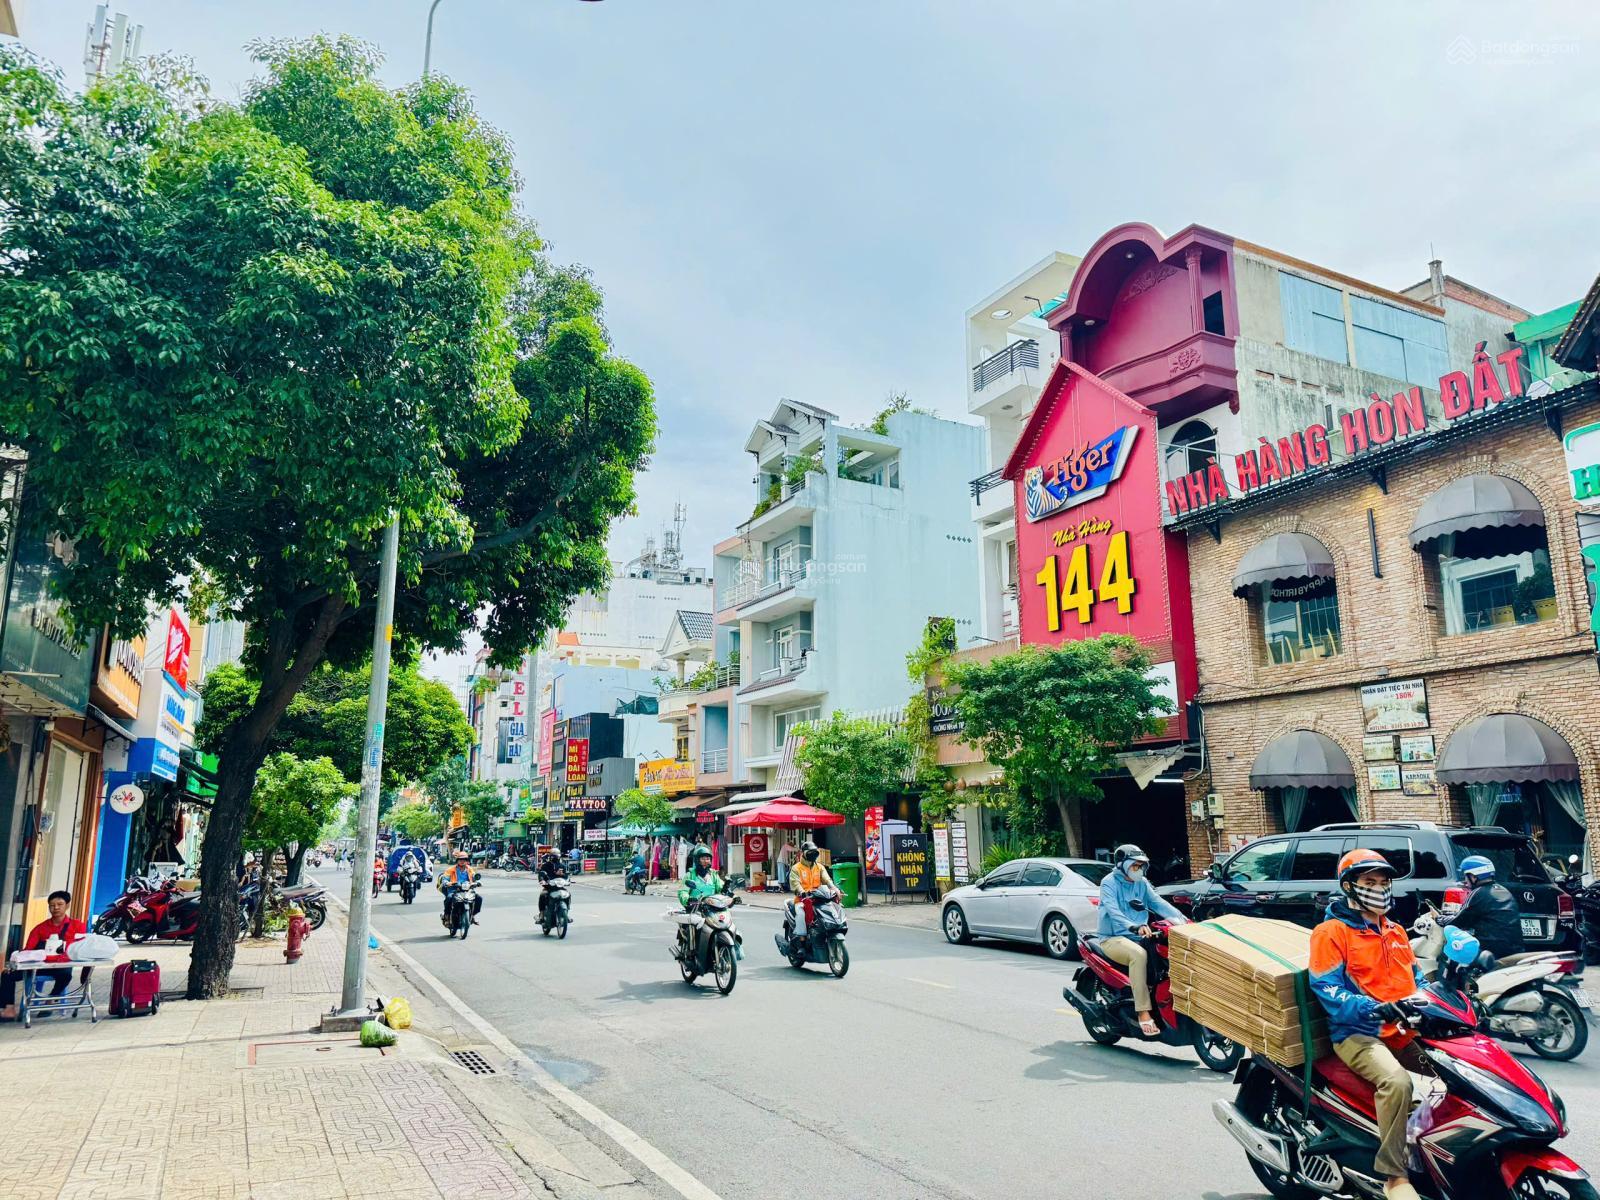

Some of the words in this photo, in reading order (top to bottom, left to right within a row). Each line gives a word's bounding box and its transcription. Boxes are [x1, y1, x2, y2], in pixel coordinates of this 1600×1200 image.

[1165, 456, 1231, 516] NHÀ
[1235, 423, 1330, 492] HÀNG
[1340, 387, 1429, 455] HÒN
[1440, 340, 1525, 420] ĐẤT
[1048, 441, 1114, 491] Tiger
[1052, 525, 1076, 547] Nhà
[1078, 516, 1112, 539] Hàng
[1036, 531, 1136, 632] 144
[510, 722, 524, 736] GIA
[570, 800, 606, 809] TATTOO
[901, 839, 919, 848] SPA
[897, 850, 925, 862] KHÔNG
[900, 862, 923, 876] NHẬN
[905, 877, 919, 887] TIP
